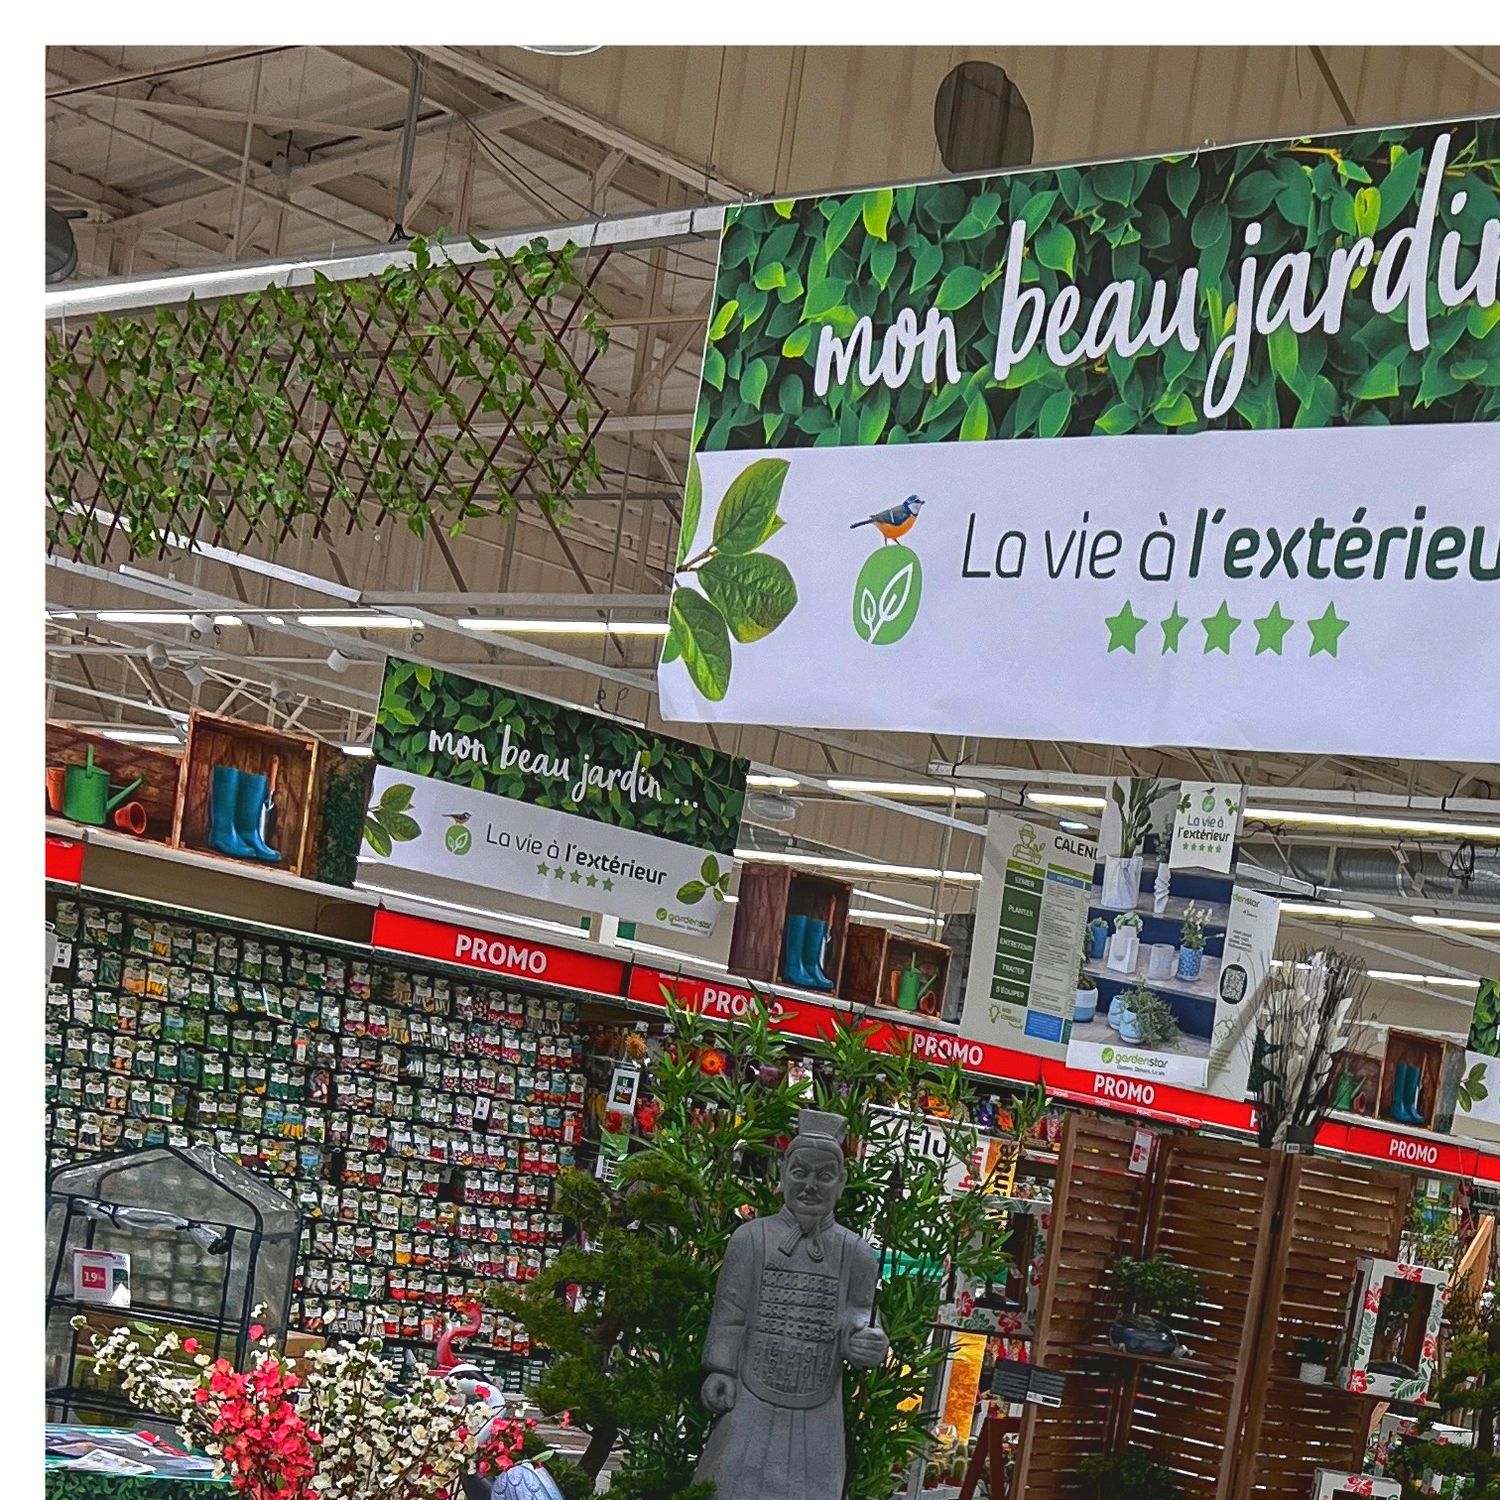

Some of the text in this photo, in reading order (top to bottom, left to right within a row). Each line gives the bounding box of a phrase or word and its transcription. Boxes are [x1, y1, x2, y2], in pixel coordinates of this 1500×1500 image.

[814, 307, 962, 397] mon
[994, 220, 1200, 381] beau
[961, 512, 1028, 579] La
[1044, 511, 1123, 579] vie
[1139, 512, 1176, 582] à
[428, 729, 488, 765] mon
[499, 724, 570, 781] beau
[571, 750, 662, 803] jardin
[1187, 815, 1201, 827] La
[1202, 816, 1217, 828] vie
[486, 823, 668, 885] La vie à l'extérieur
[1054, 835, 1097, 861] CALEN
[453, 933, 548, 976] PROMO
[912, 1032, 985, 1068] PROMO
[1115, 1053, 1168, 1068] gardenstar
[1093, 1074, 1155, 1105] PROMO
[1389, 1138, 1438, 1164] PROMO
